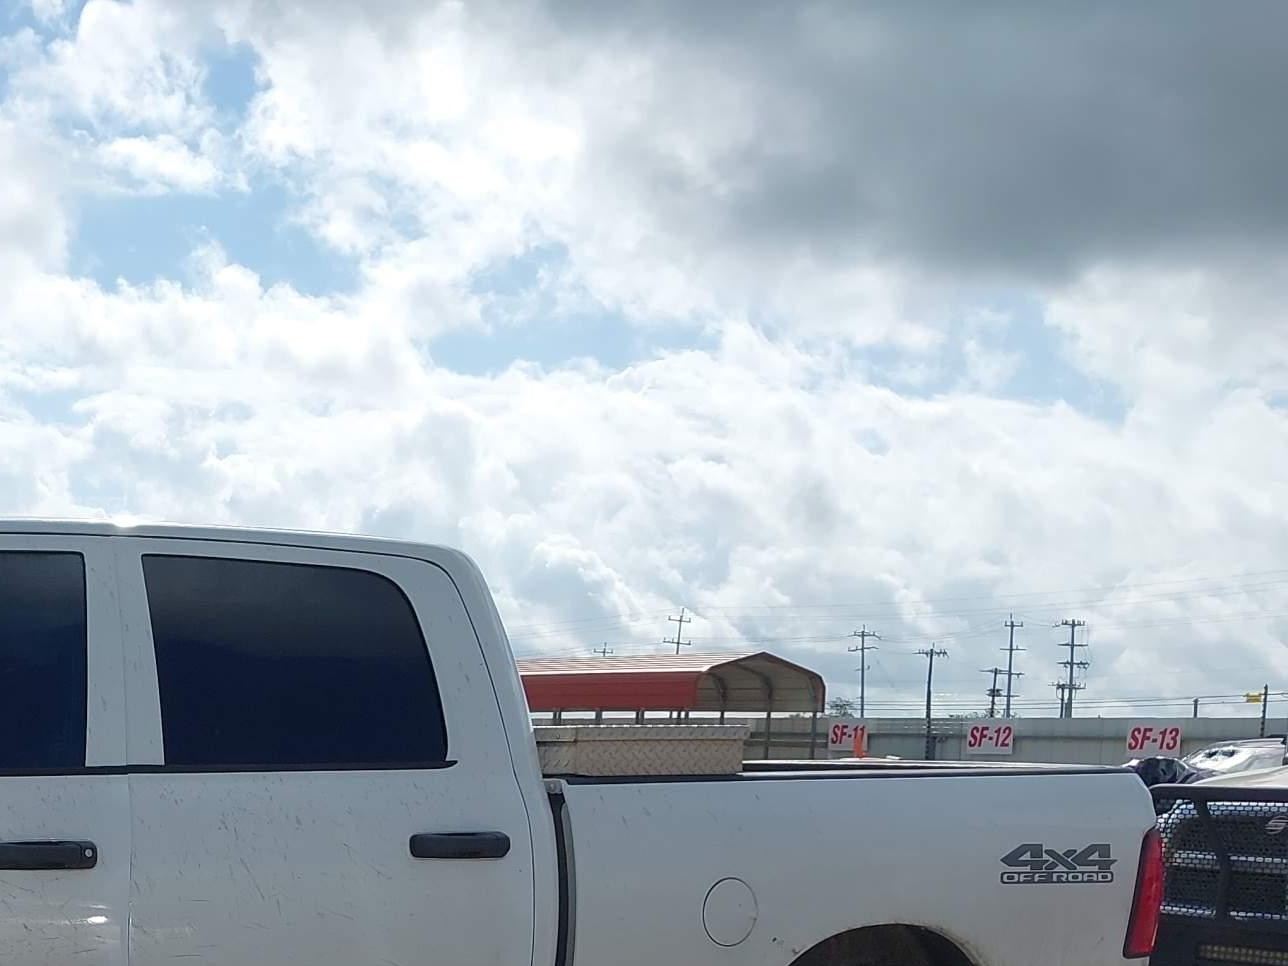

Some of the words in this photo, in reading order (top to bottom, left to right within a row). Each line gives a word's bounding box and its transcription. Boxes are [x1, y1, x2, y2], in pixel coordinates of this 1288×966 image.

[968, 726, 1012, 747] SF-12
[1128, 727, 1180, 750] SF-13
[1002, 872, 1047, 883] OFF
[1052, 872, 1112, 882] ROAD
